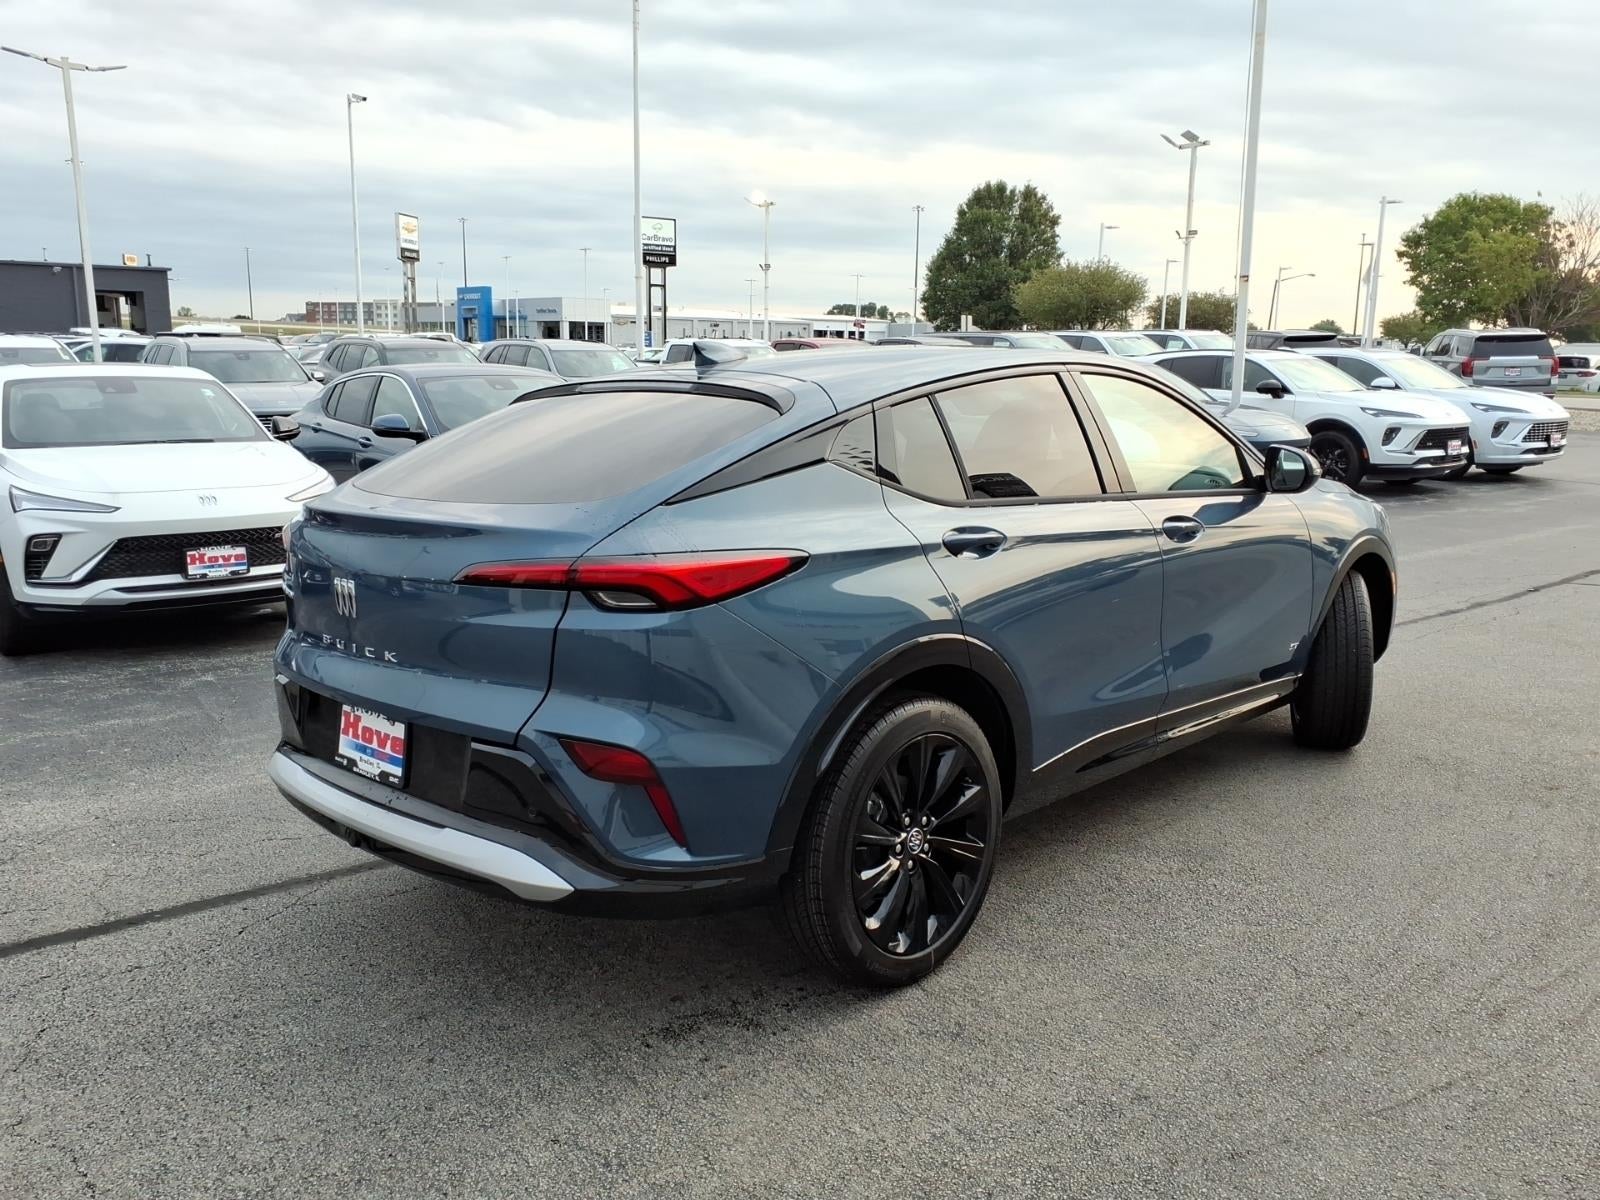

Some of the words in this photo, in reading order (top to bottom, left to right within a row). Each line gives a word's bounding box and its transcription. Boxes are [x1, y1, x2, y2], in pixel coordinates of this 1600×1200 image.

[641, 233, 673, 243] CarBravo
[188, 553, 246, 565] Hove
[322, 634, 399, 662] BUICK
[341, 709, 405, 756] Hove
